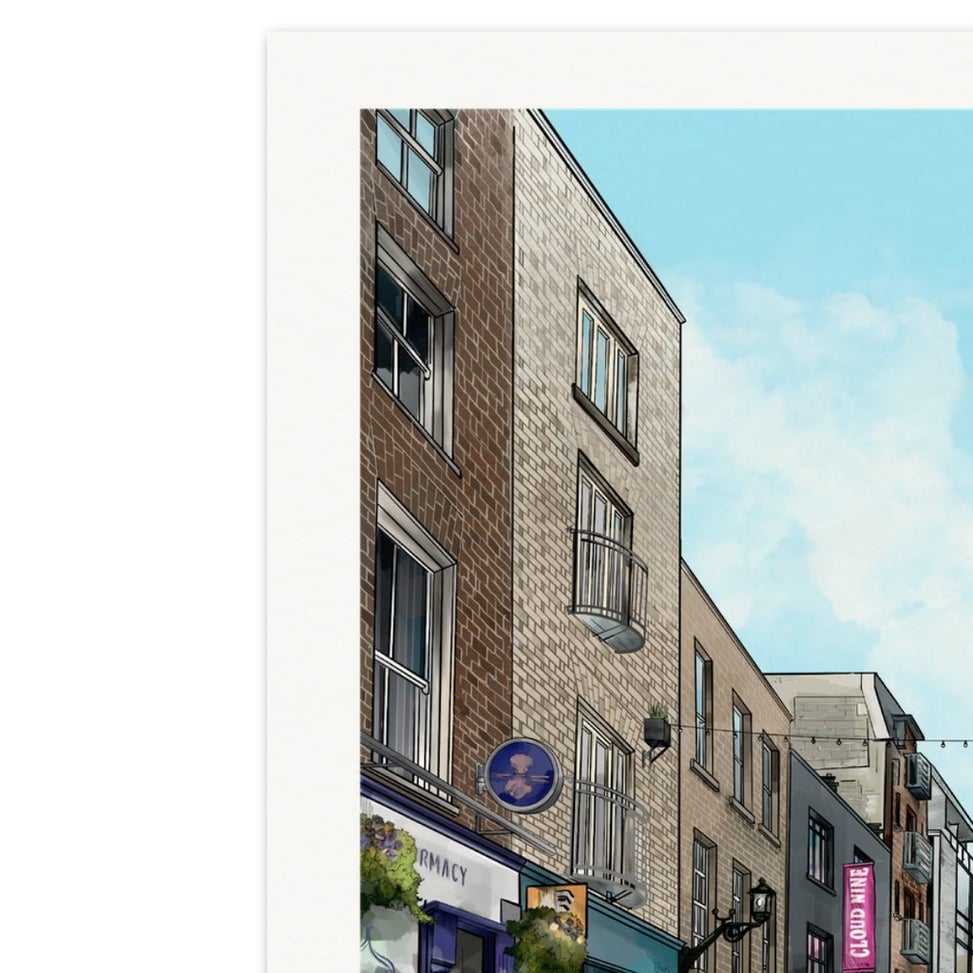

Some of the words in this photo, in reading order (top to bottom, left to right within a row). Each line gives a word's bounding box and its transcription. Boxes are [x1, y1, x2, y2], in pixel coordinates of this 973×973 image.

[419, 848, 468, 886] RMACY
[849, 866, 870, 903] NINE
[849, 908, 871, 958] CLOUD
